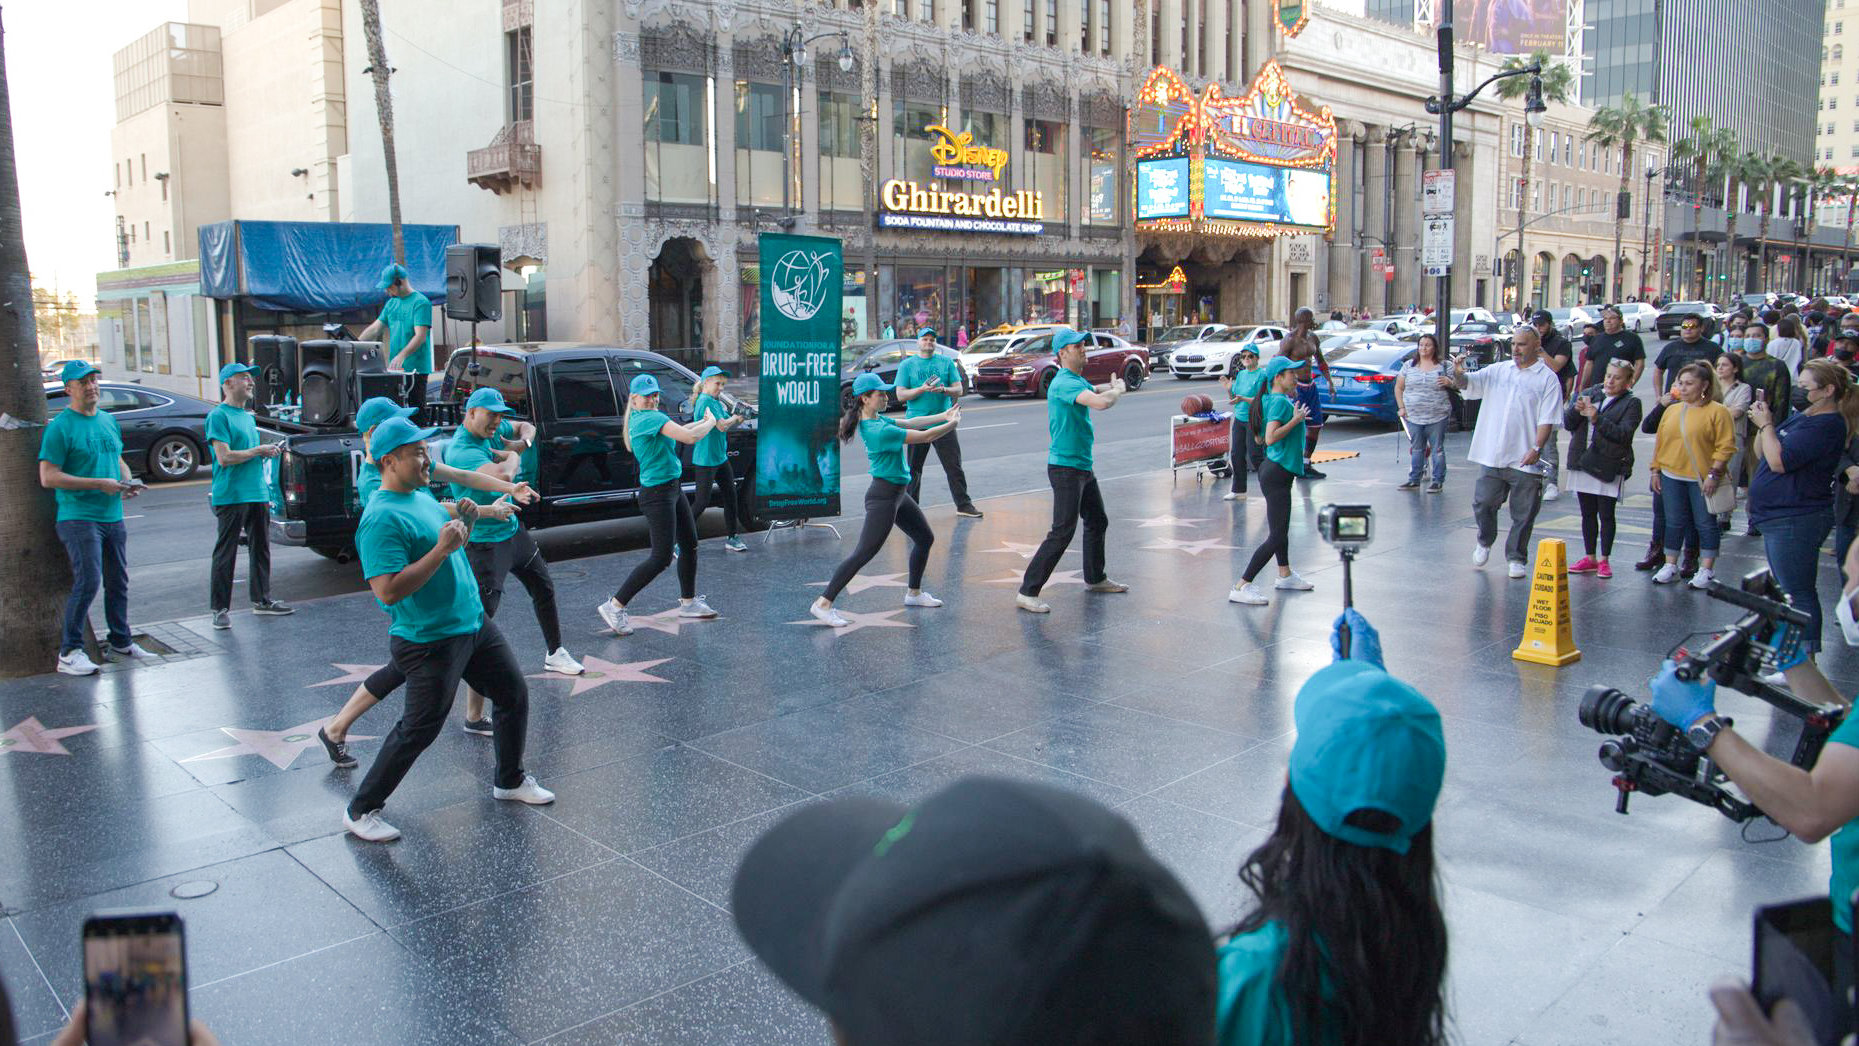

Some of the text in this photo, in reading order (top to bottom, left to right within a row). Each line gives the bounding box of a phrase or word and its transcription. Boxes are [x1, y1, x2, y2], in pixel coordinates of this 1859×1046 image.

[1520, 39, 1555, 47] FEBRUARY
[1231, 114, 1250, 136] EL
[934, 167, 993, 181] STUDIO STORE
[883, 179, 1044, 220] Ghirardelli
[884, 216, 1043, 233] SODA FOUNTAIN AND CHOCOLATE SHOP
[763, 340, 813, 349] FOUNDATION
[814, 341, 828, 349] FOR
[763, 352, 836, 376] DRUG-FREE
[776, 380, 820, 405] WORLD
[1536, 571, 1554, 581] CAUTION
[1534, 583, 1554, 593] CUIDADO
[1529, 618, 1553, 626] MOJADO
